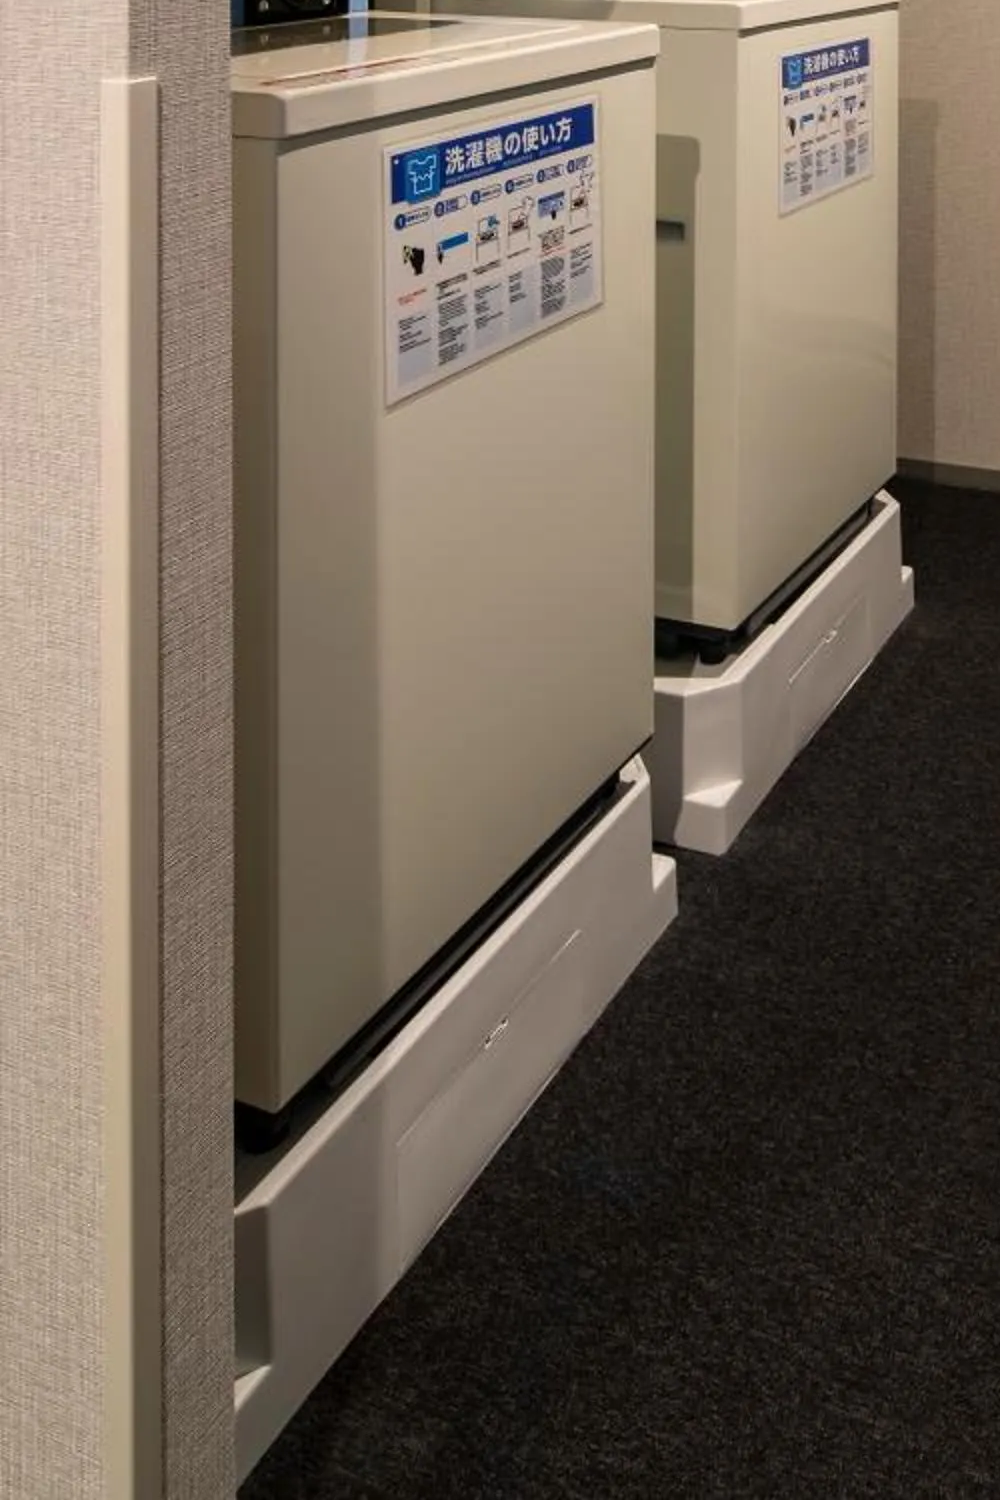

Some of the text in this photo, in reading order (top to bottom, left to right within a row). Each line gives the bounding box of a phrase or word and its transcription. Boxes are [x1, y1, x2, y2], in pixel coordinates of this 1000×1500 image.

[445, 116, 573, 177] 洗濯機の使い方
